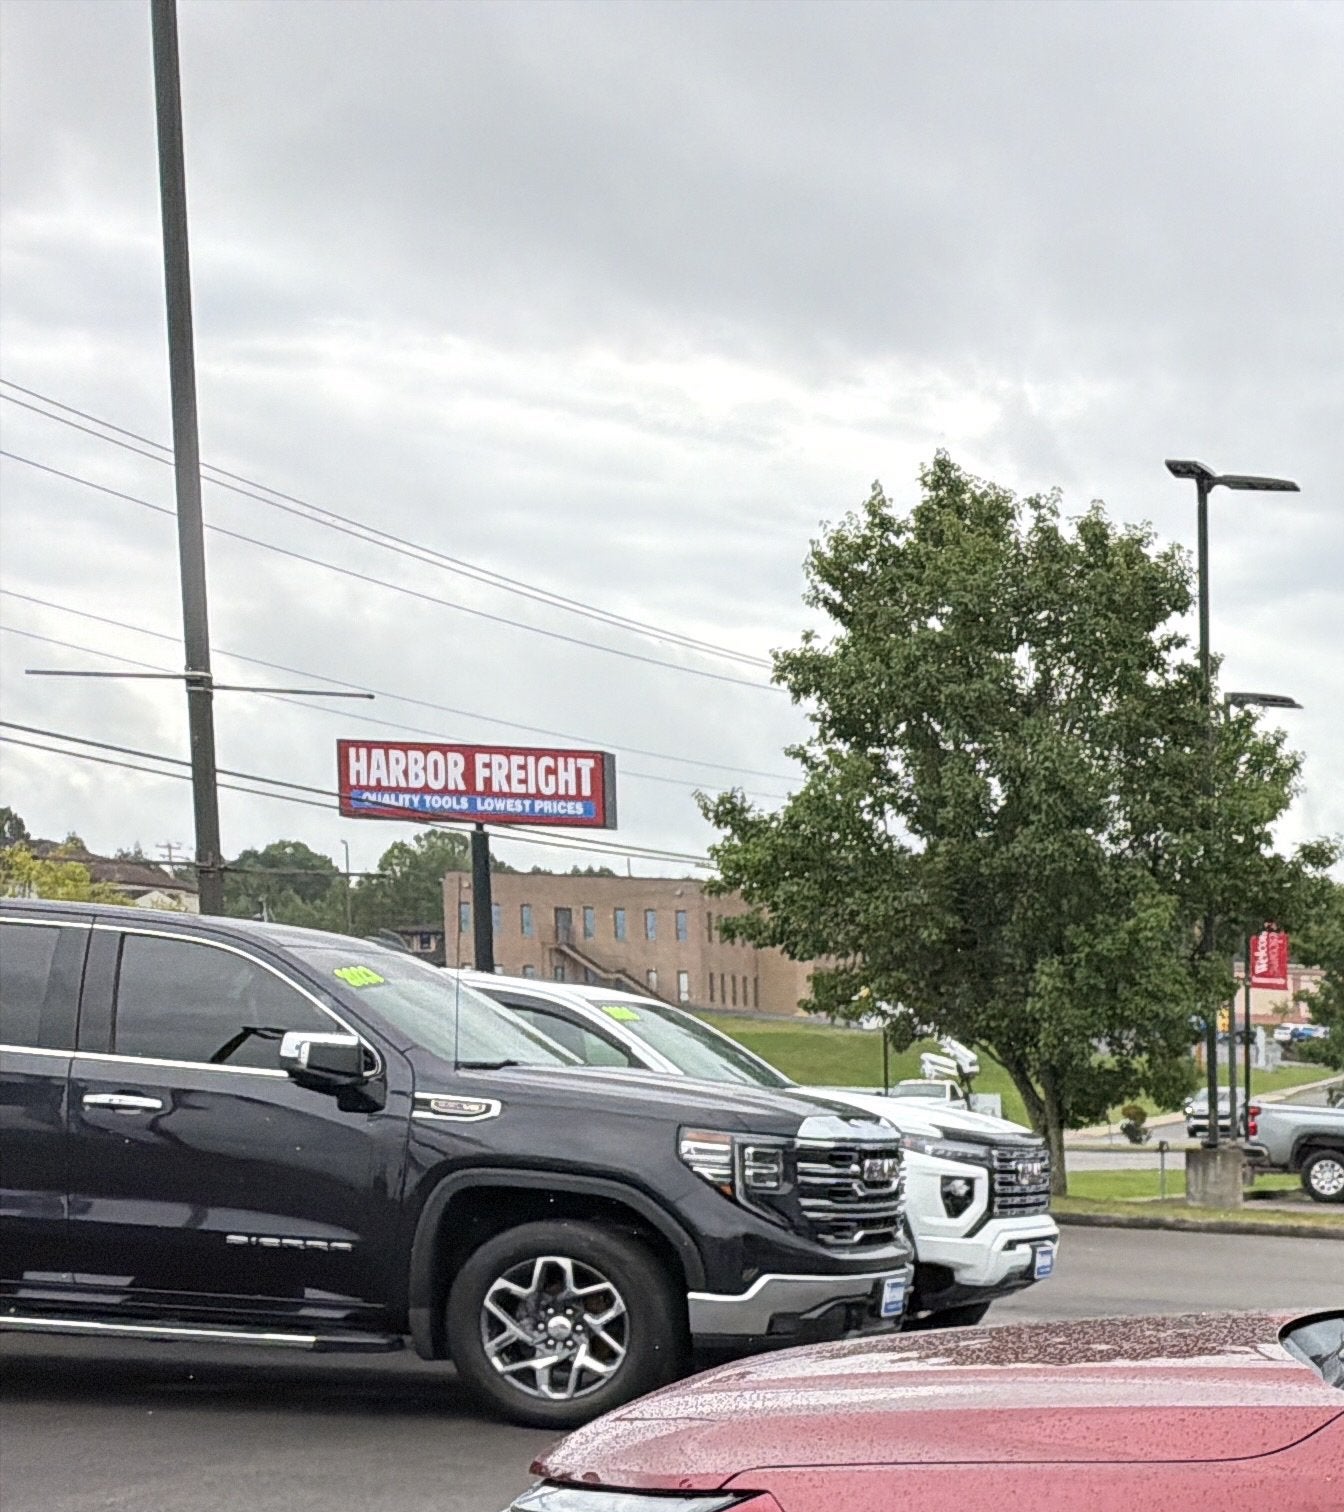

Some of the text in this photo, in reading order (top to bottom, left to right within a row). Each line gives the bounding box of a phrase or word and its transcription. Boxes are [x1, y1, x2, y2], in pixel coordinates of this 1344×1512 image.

[349, 747, 595, 797] HARBOR FREIGHT
[361, 791, 584, 815] QUALITY TOOLS LOWEST PRICES
